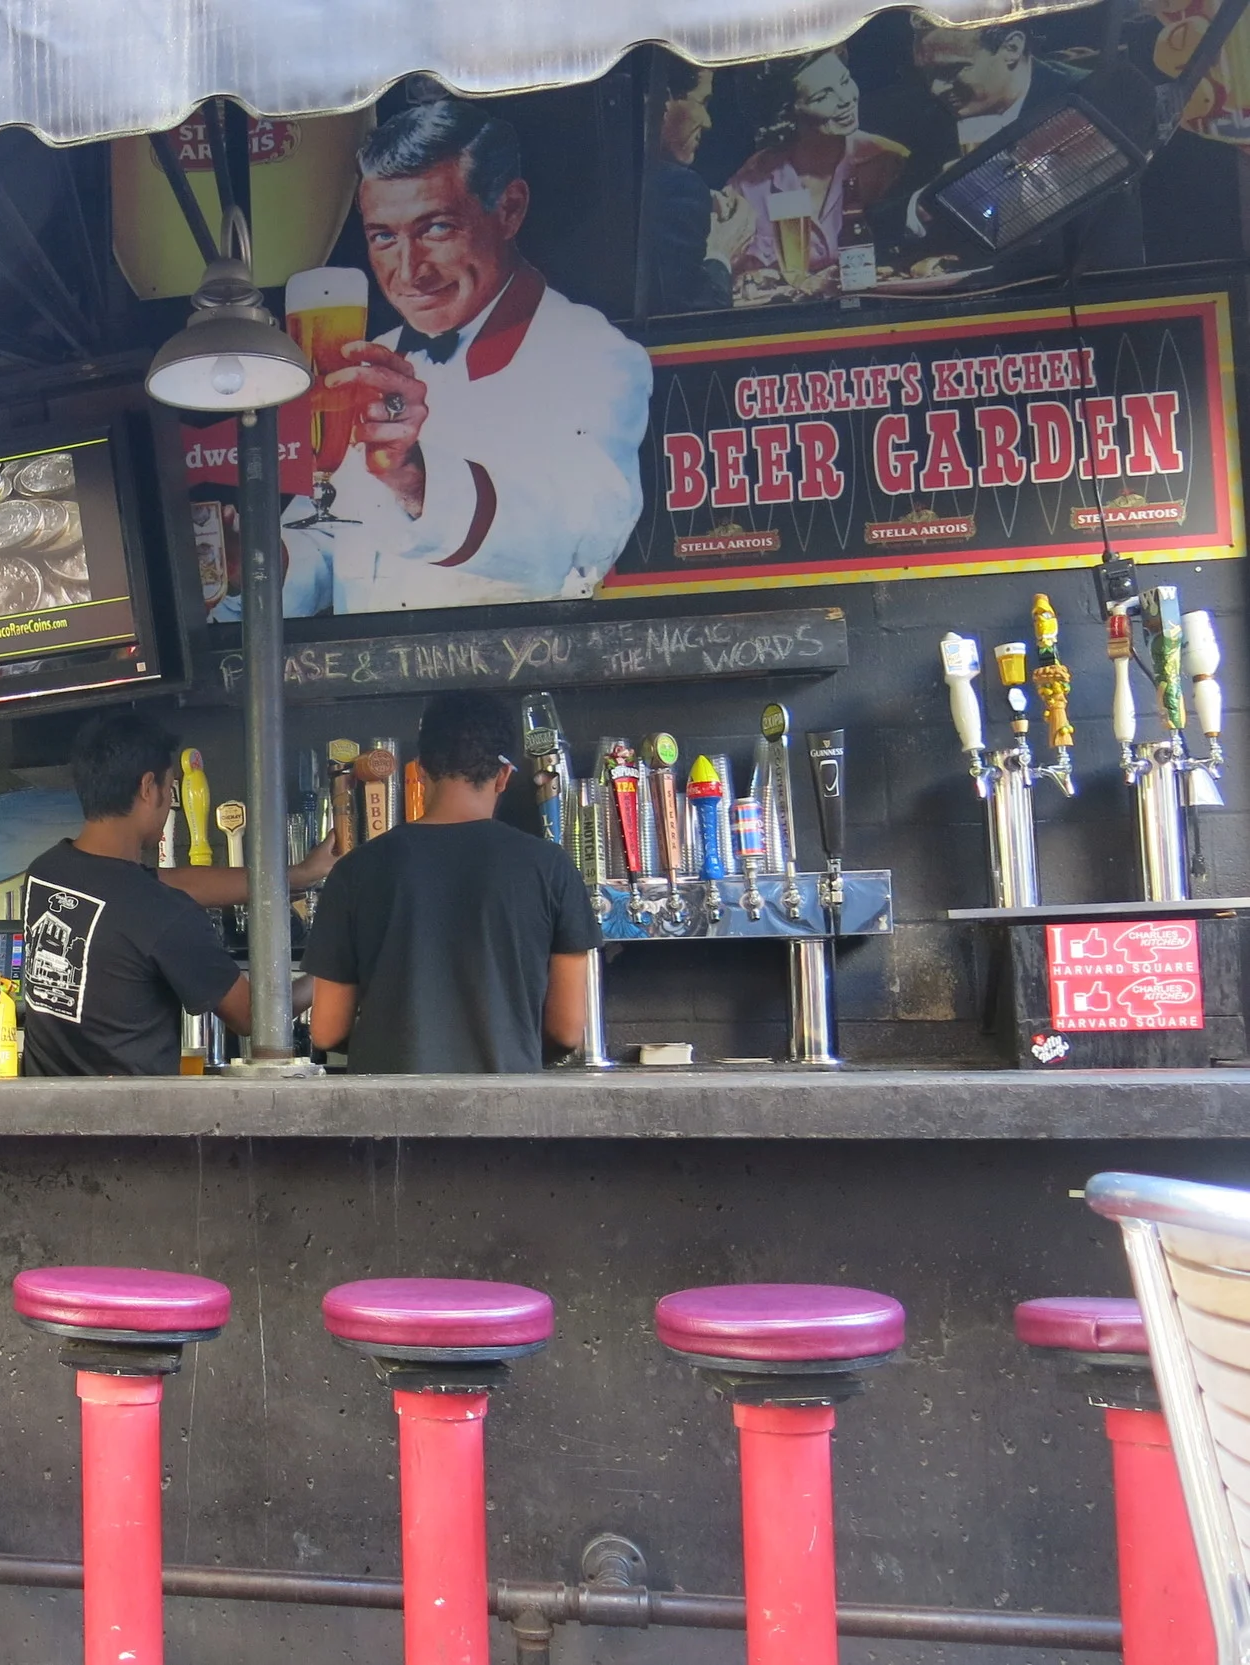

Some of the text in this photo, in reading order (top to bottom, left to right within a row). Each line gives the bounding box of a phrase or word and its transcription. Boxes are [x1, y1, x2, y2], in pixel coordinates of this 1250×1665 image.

[179, 119, 274, 141] STA
[179, 134, 275, 160] ARIS
[735, 347, 1097, 420] CHARLIE'S KITCHEN
[664, 390, 1184, 512] BEER GARDEN
[1127, 507, 1178, 520] ARTOIS
[871, 522, 968, 539] STELLA ARTOIS
[680, 537, 774, 553] STELLA ARTOIS
[219, 650, 347, 693] PASE
[351, 651, 379, 683] &
[390, 643, 491, 681] THANK
[502, 635, 572, 682] YOU
[601, 647, 646, 677] THE
[645, 622, 732, 667] MAGIC
[702, 623, 824, 674] WORDS
[810, 747, 844, 757] GUINNESS
[616, 781, 636, 793] IPA
[666, 790, 677, 850] SIERRA
[583, 821, 595, 861] NOTCH
[1051, 928, 1179, 965] I CHARLIES
[1140, 938, 1186, 947] KITCHEN
[1053, 962, 1195, 976] HARVARD SQUARE
[1053, 980, 1183, 1018] I CHARLIES
[1143, 991, 1190, 1001] KITCHEN
[1056, 1016, 1199, 1029] HARVARD SQUARE
